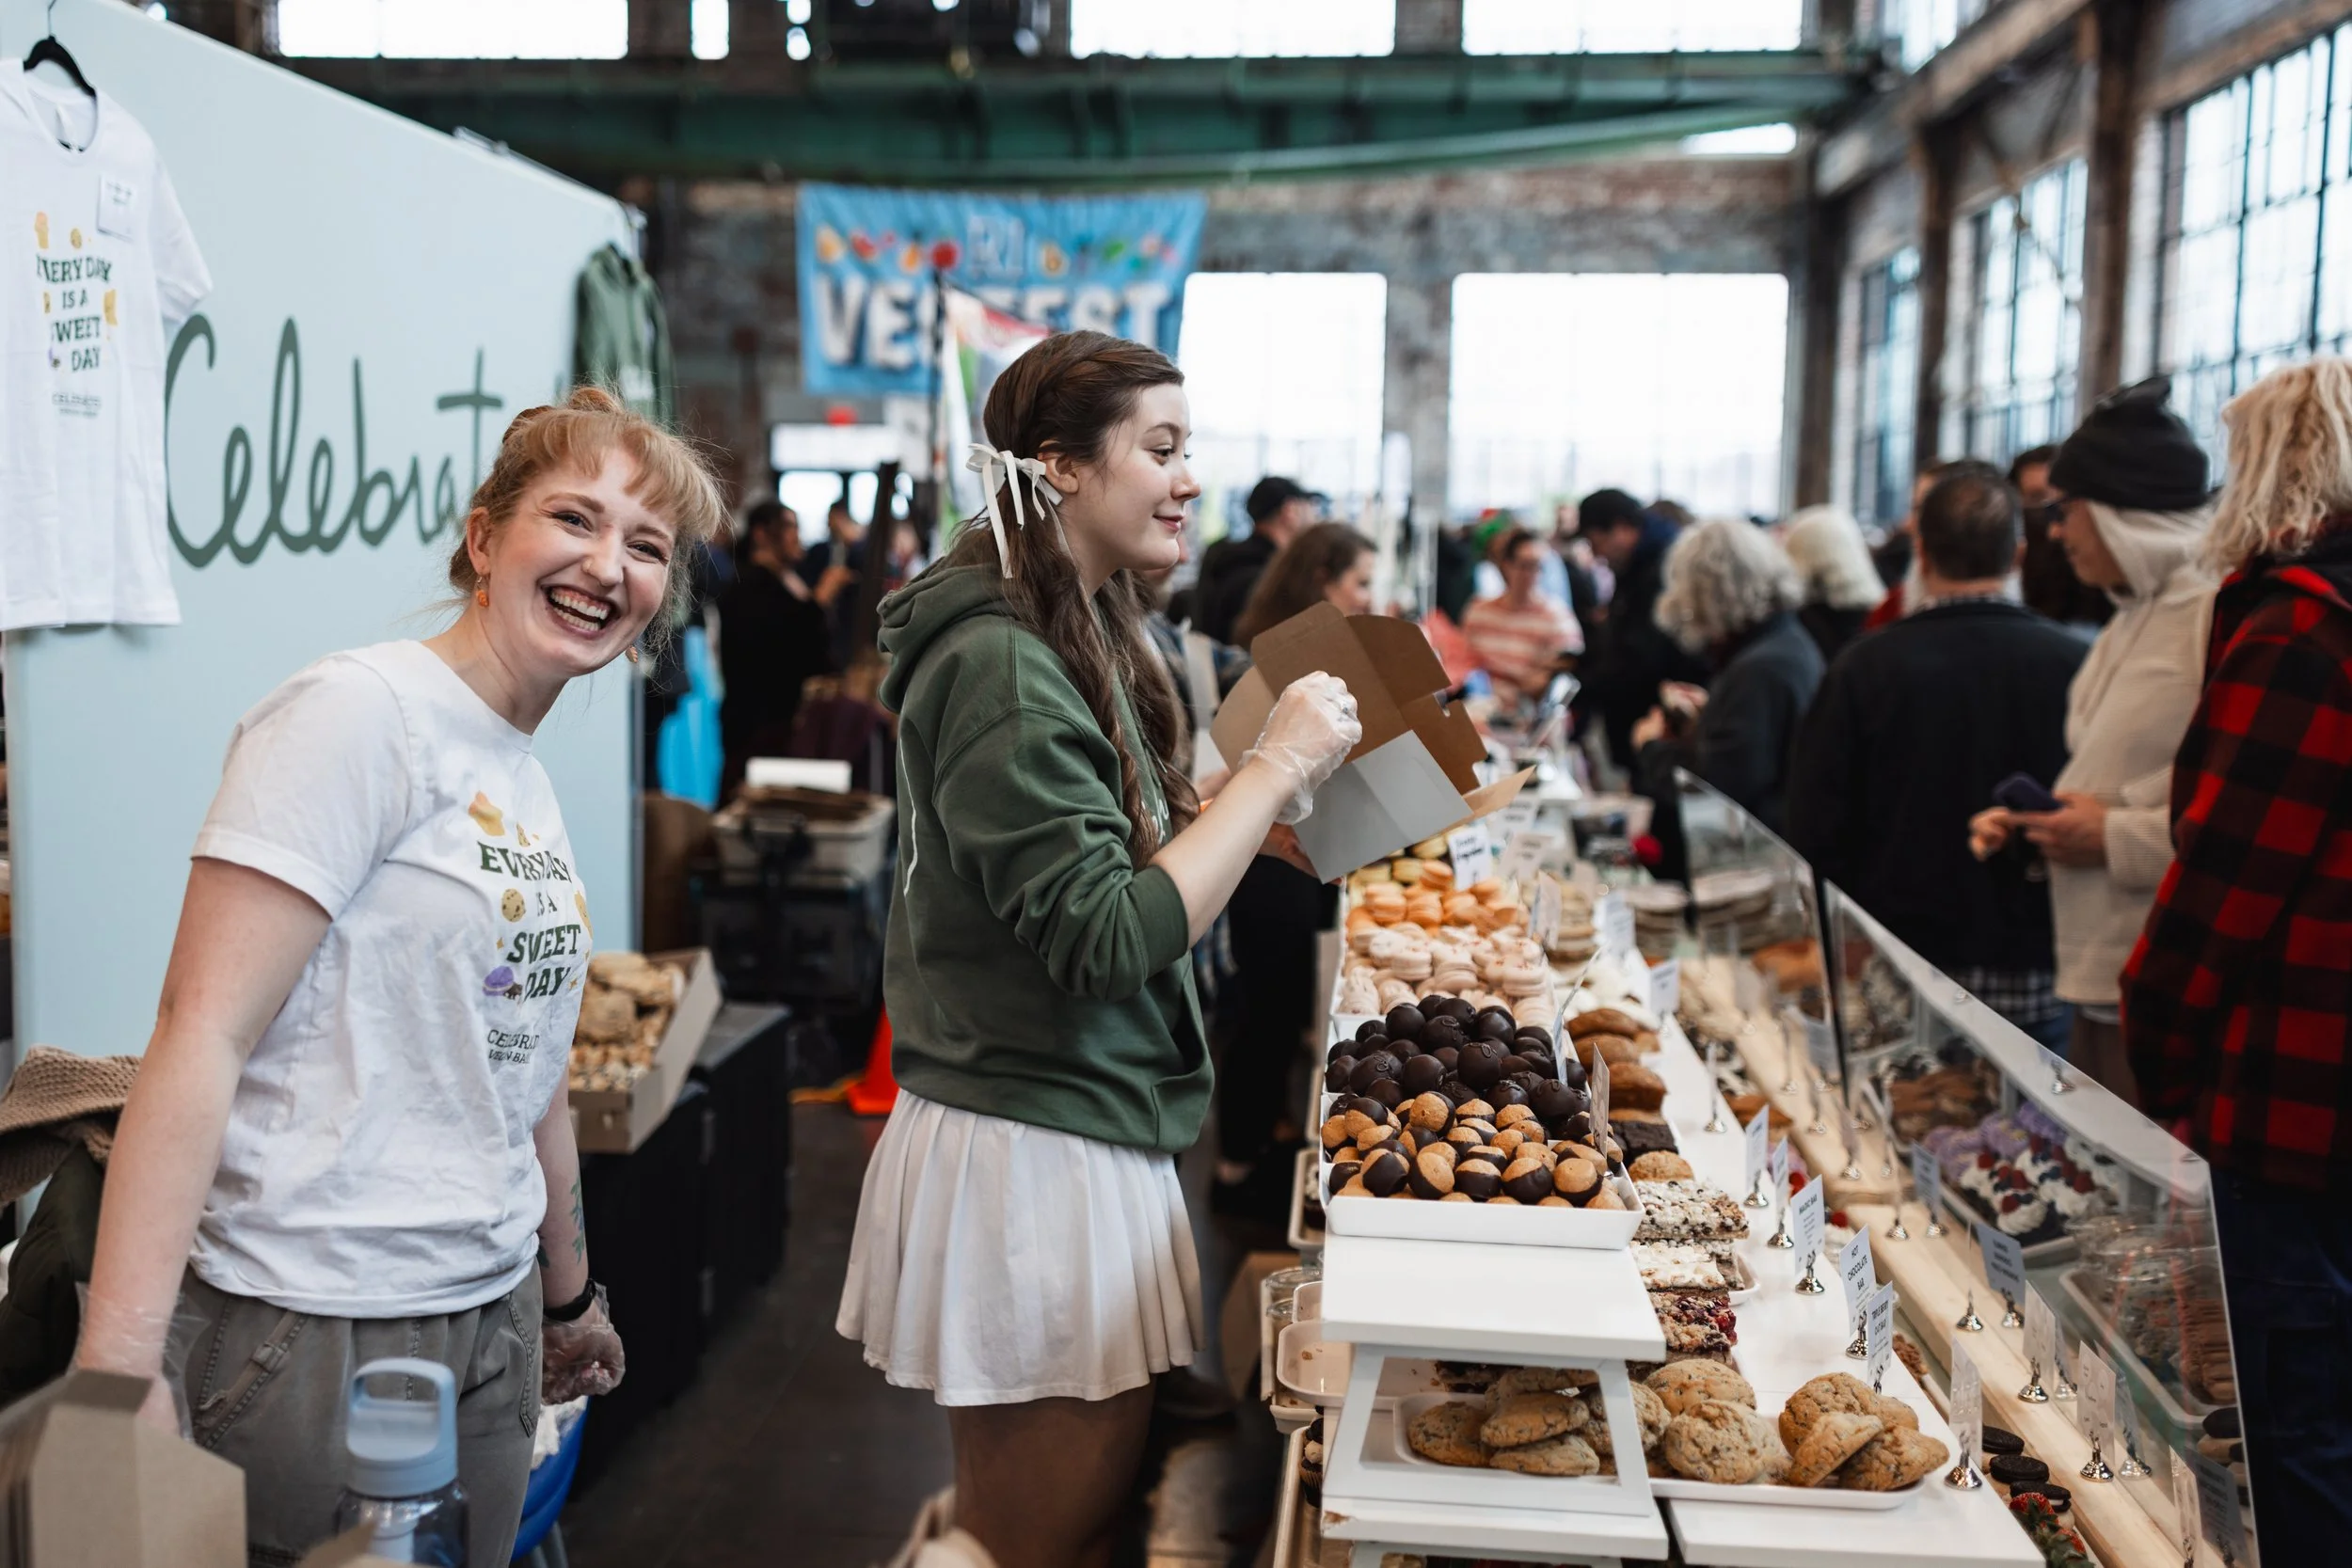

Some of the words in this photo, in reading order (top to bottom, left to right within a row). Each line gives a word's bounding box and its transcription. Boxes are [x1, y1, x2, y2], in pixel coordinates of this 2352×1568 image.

[62, 291, 75, 309] IS
[1851, 1244, 1859, 1259] HOT
[1847, 1254, 1868, 1281] CHOCOLATE
[1856, 1277, 1865, 1291] BAR
